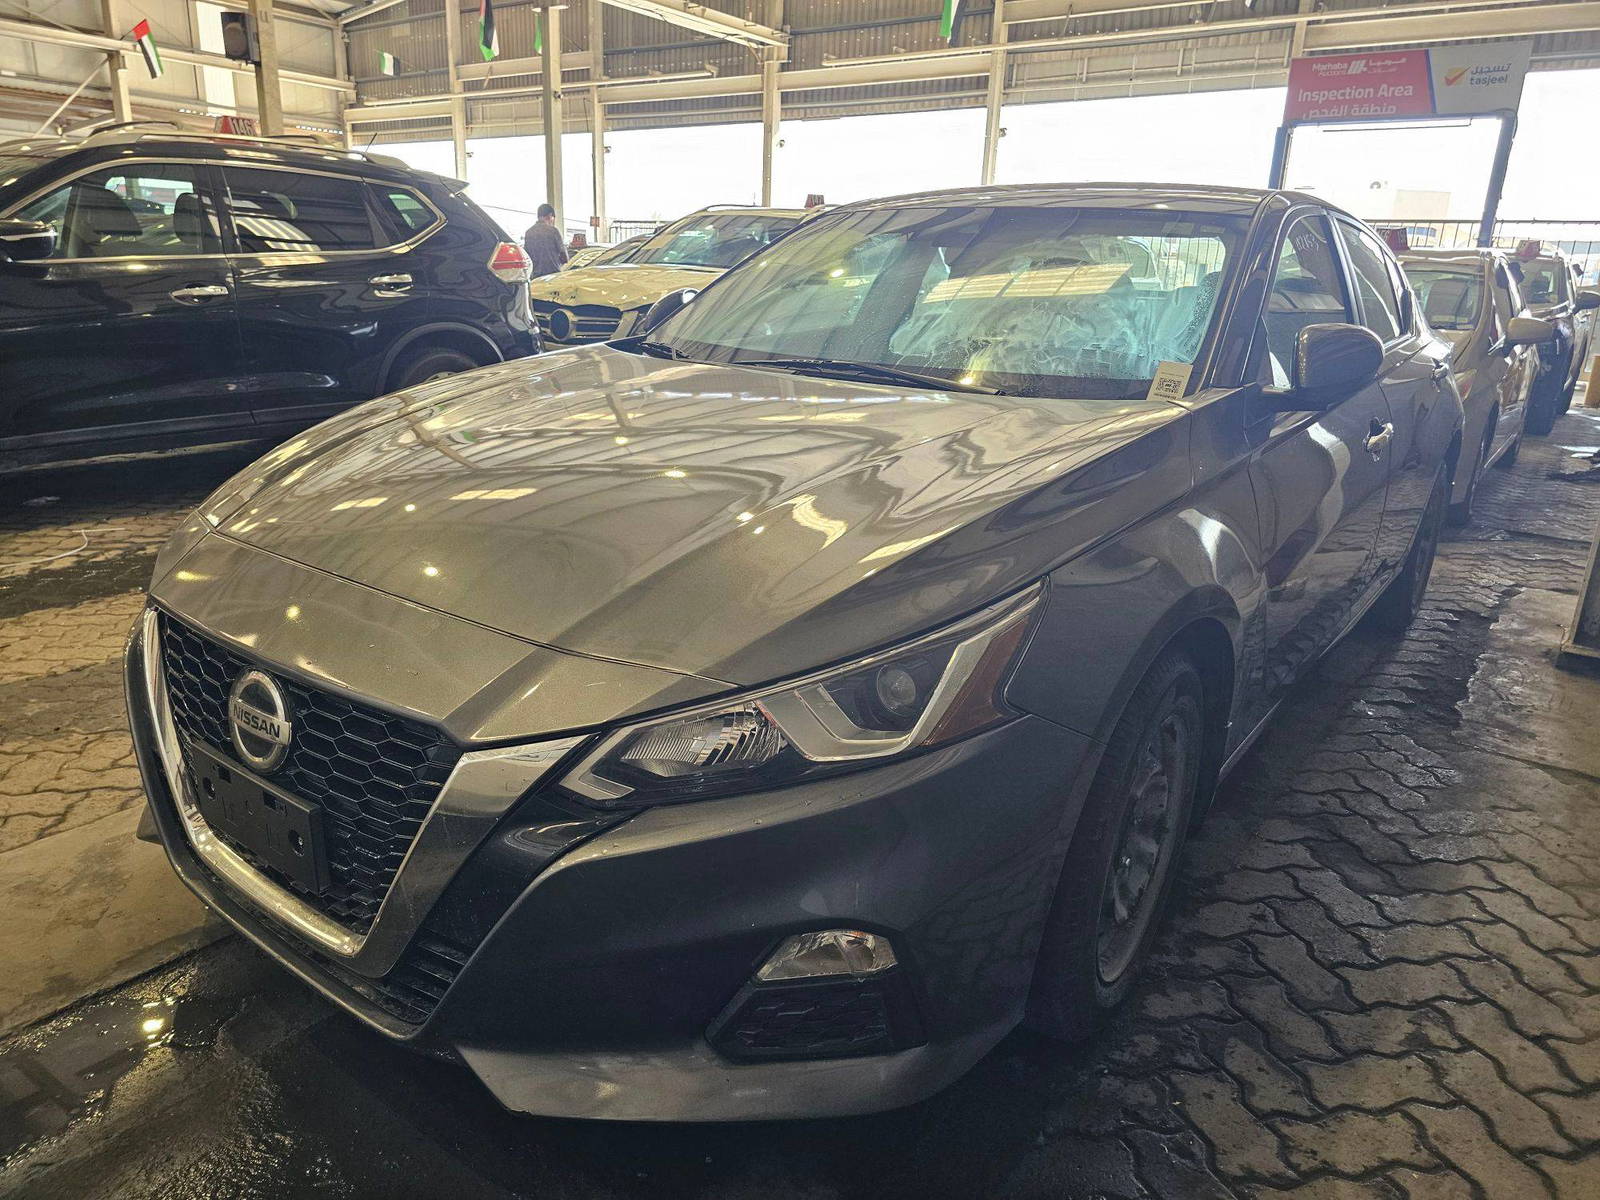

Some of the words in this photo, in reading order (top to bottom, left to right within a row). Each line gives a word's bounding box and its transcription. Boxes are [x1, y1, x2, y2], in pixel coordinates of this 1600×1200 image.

[1312, 61, 1348, 73] Marhaba
[1471, 63, 1512, 75] تسجيل
[1470, 74, 1508, 87] tasjeel
[1298, 86, 1374, 104] Inspection
[1377, 83, 1414, 97] Area
[232, 703, 281, 739] NISSAN
